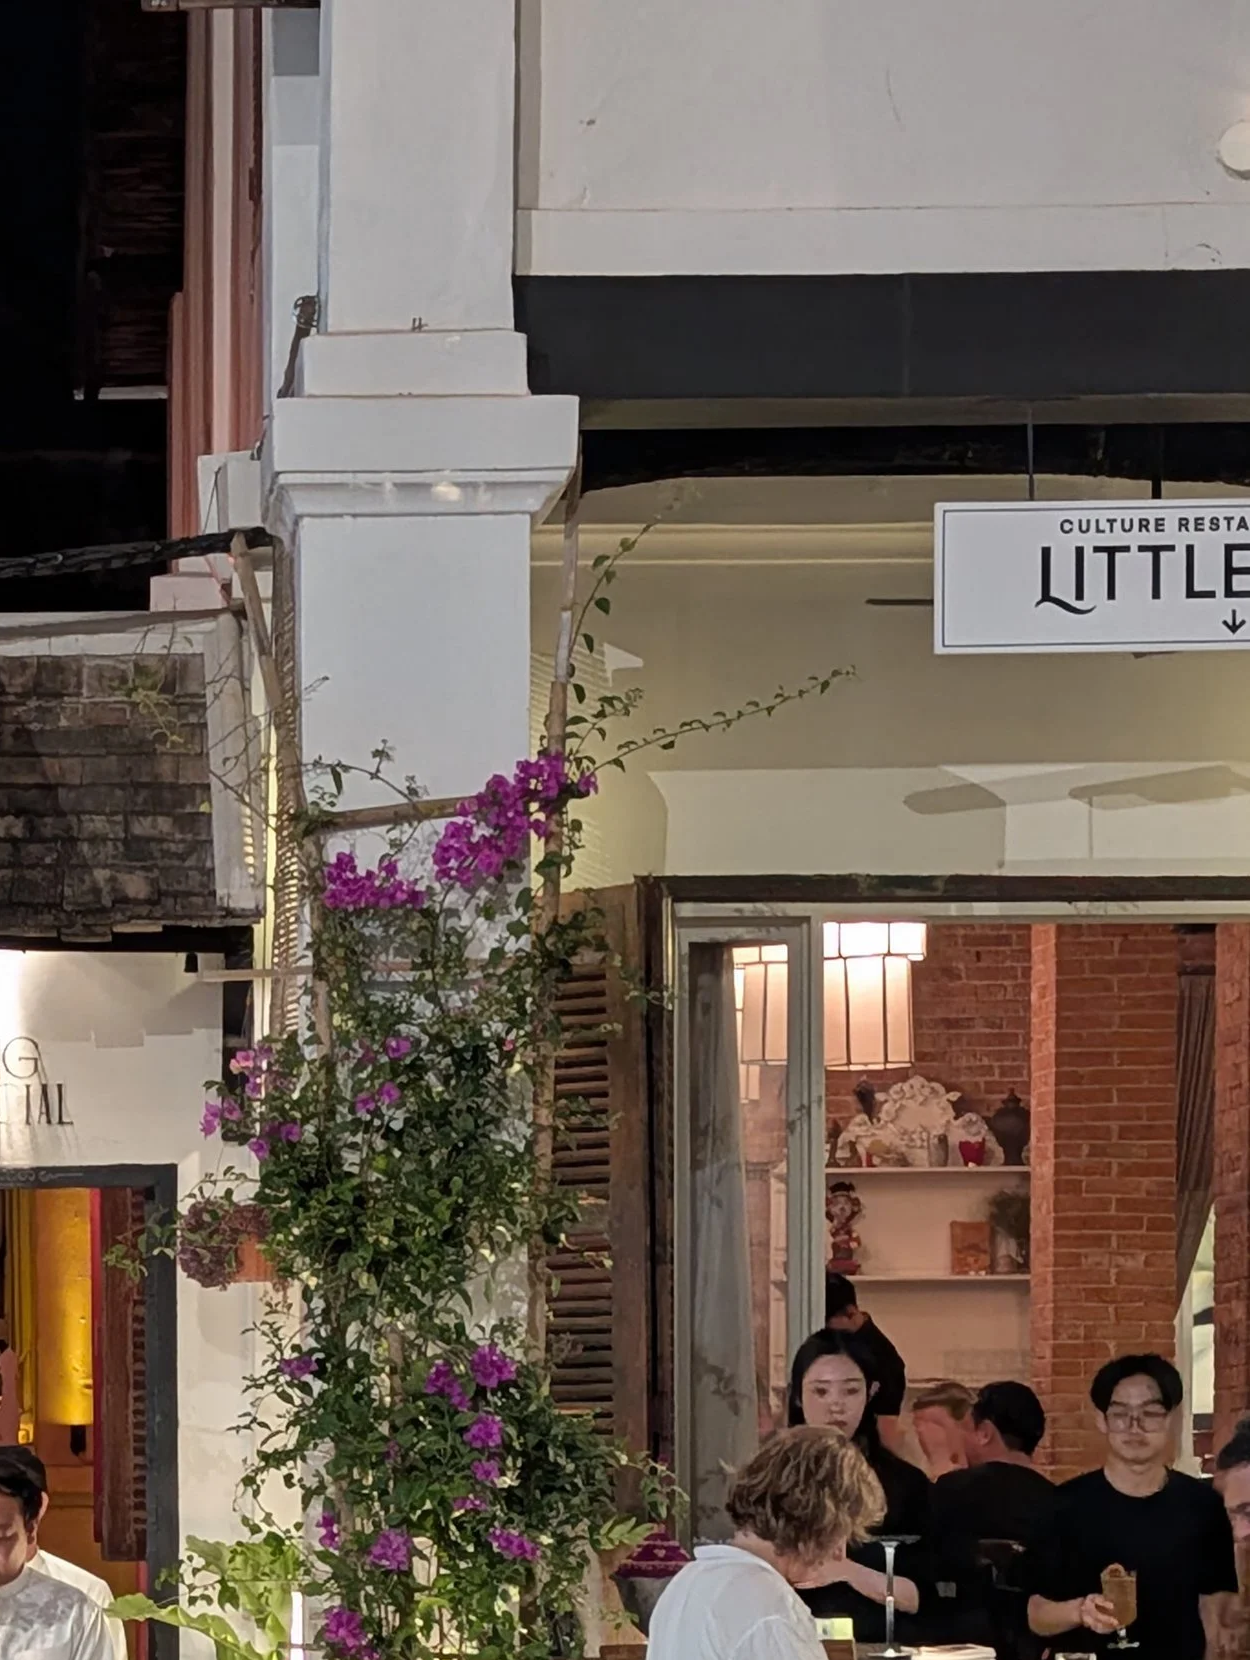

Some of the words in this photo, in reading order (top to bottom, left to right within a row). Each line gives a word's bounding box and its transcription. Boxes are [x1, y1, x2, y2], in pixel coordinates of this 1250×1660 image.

[1059, 517, 1166, 534] CULTURE
[1177, 516, 1249, 532] RESTA
[1034, 543, 1250, 615] LITTLE
